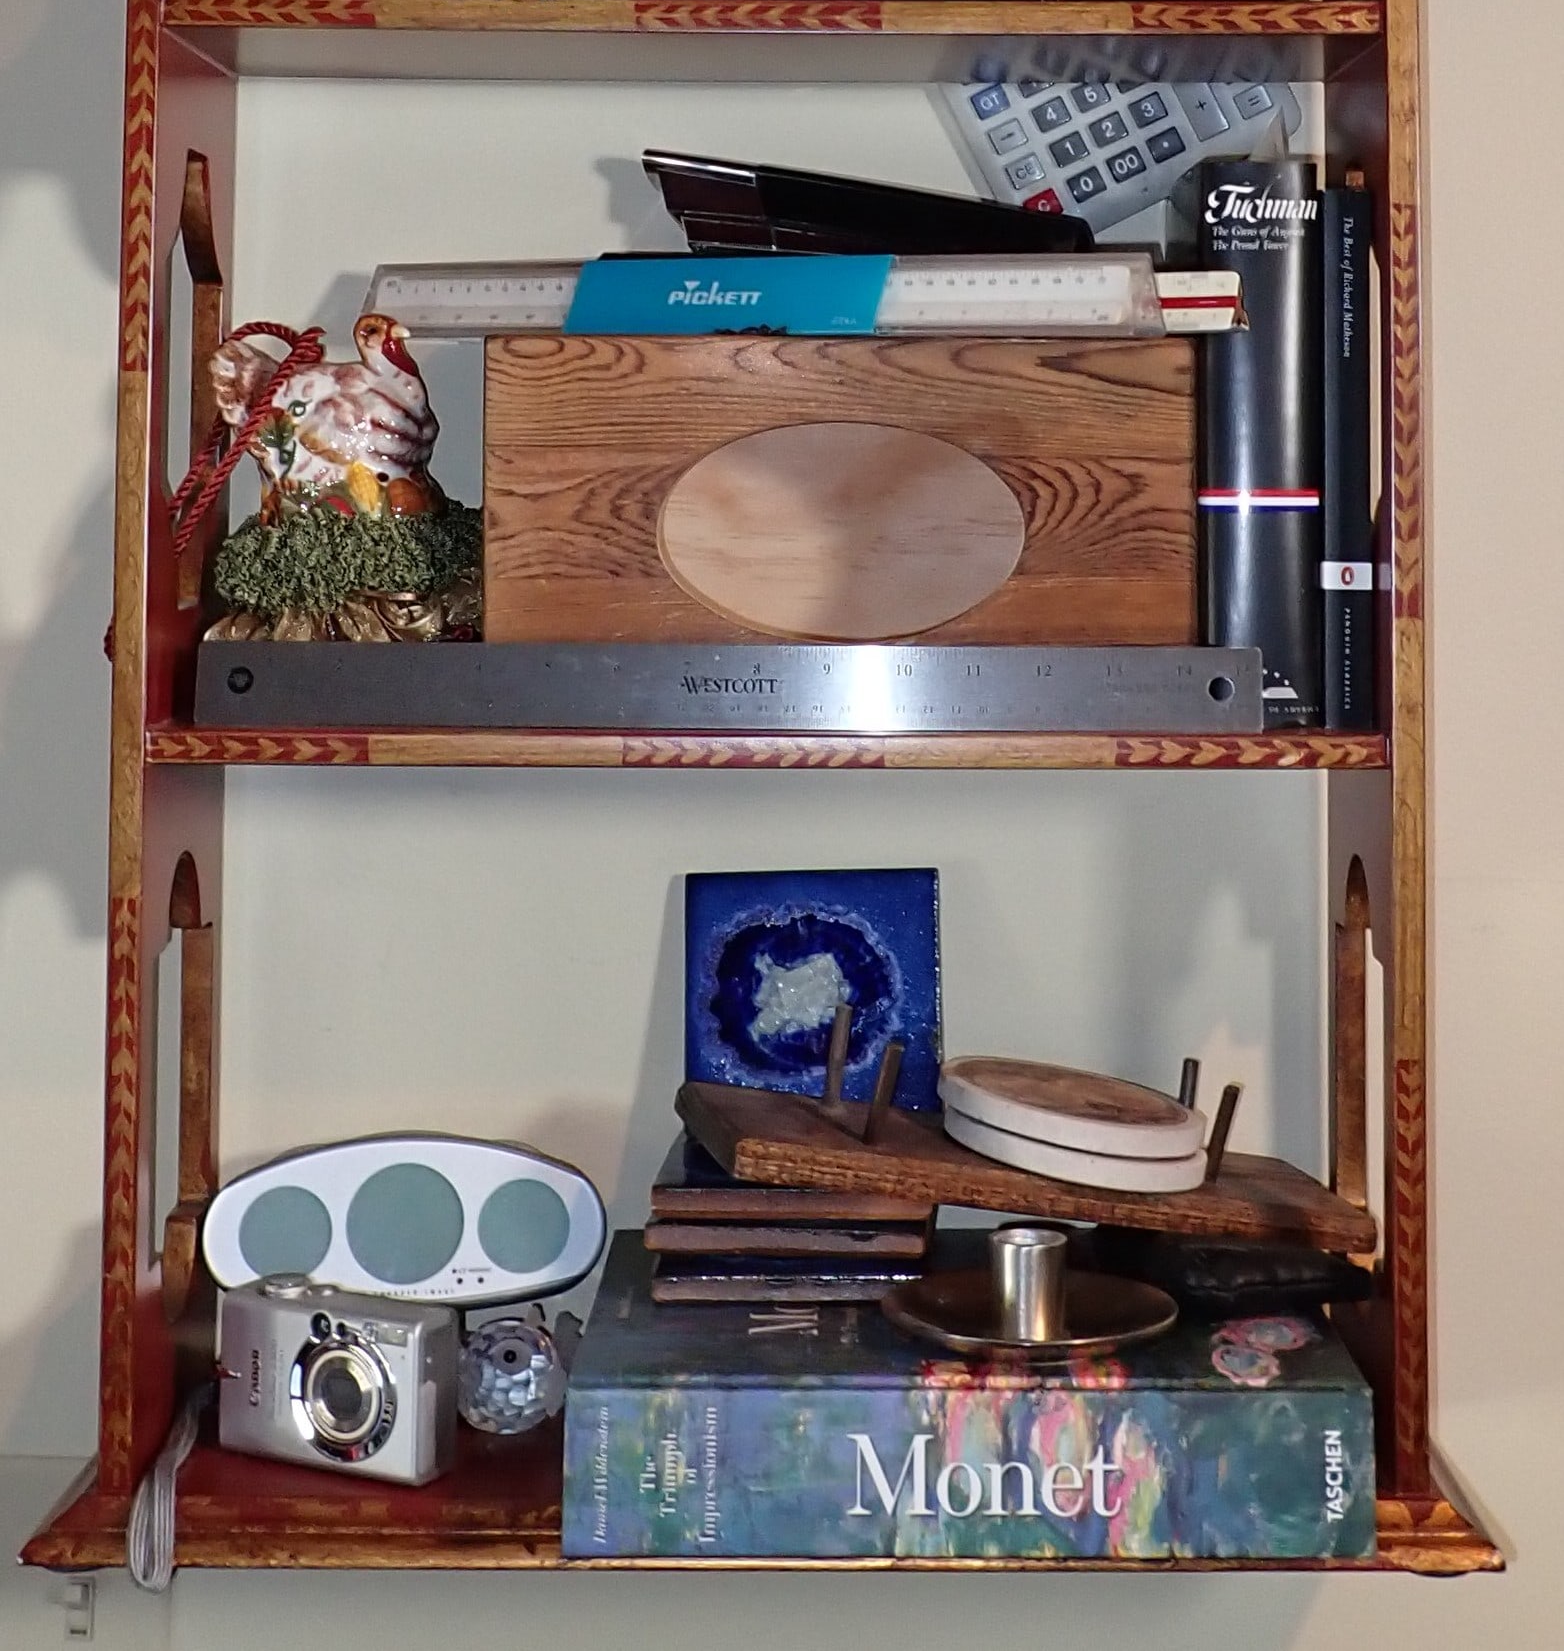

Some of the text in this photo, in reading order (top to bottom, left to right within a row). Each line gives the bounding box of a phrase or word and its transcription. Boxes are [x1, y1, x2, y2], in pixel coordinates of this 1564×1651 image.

[1046, 107, 1057, 121] 4
[1142, 103, 1155, 117] 3
[1101, 121, 1115, 137] 2
[1064, 141, 1076, 156] 1
[1113, 153, 1139, 175] 00
[1204, 182, 1318, 224] Tuchman
[823, 663, 832, 675] 9
[966, 664, 982, 677] 11
[1036, 664, 1053, 677] 12
[639, 1455, 656, 1494] The
[659, 1428, 687, 1518] Triumph
[698, 1406, 721, 1543] Impressionism
[846, 1433, 1123, 1519] Monet
[1321, 1429, 1345, 1523] TASCHEN
